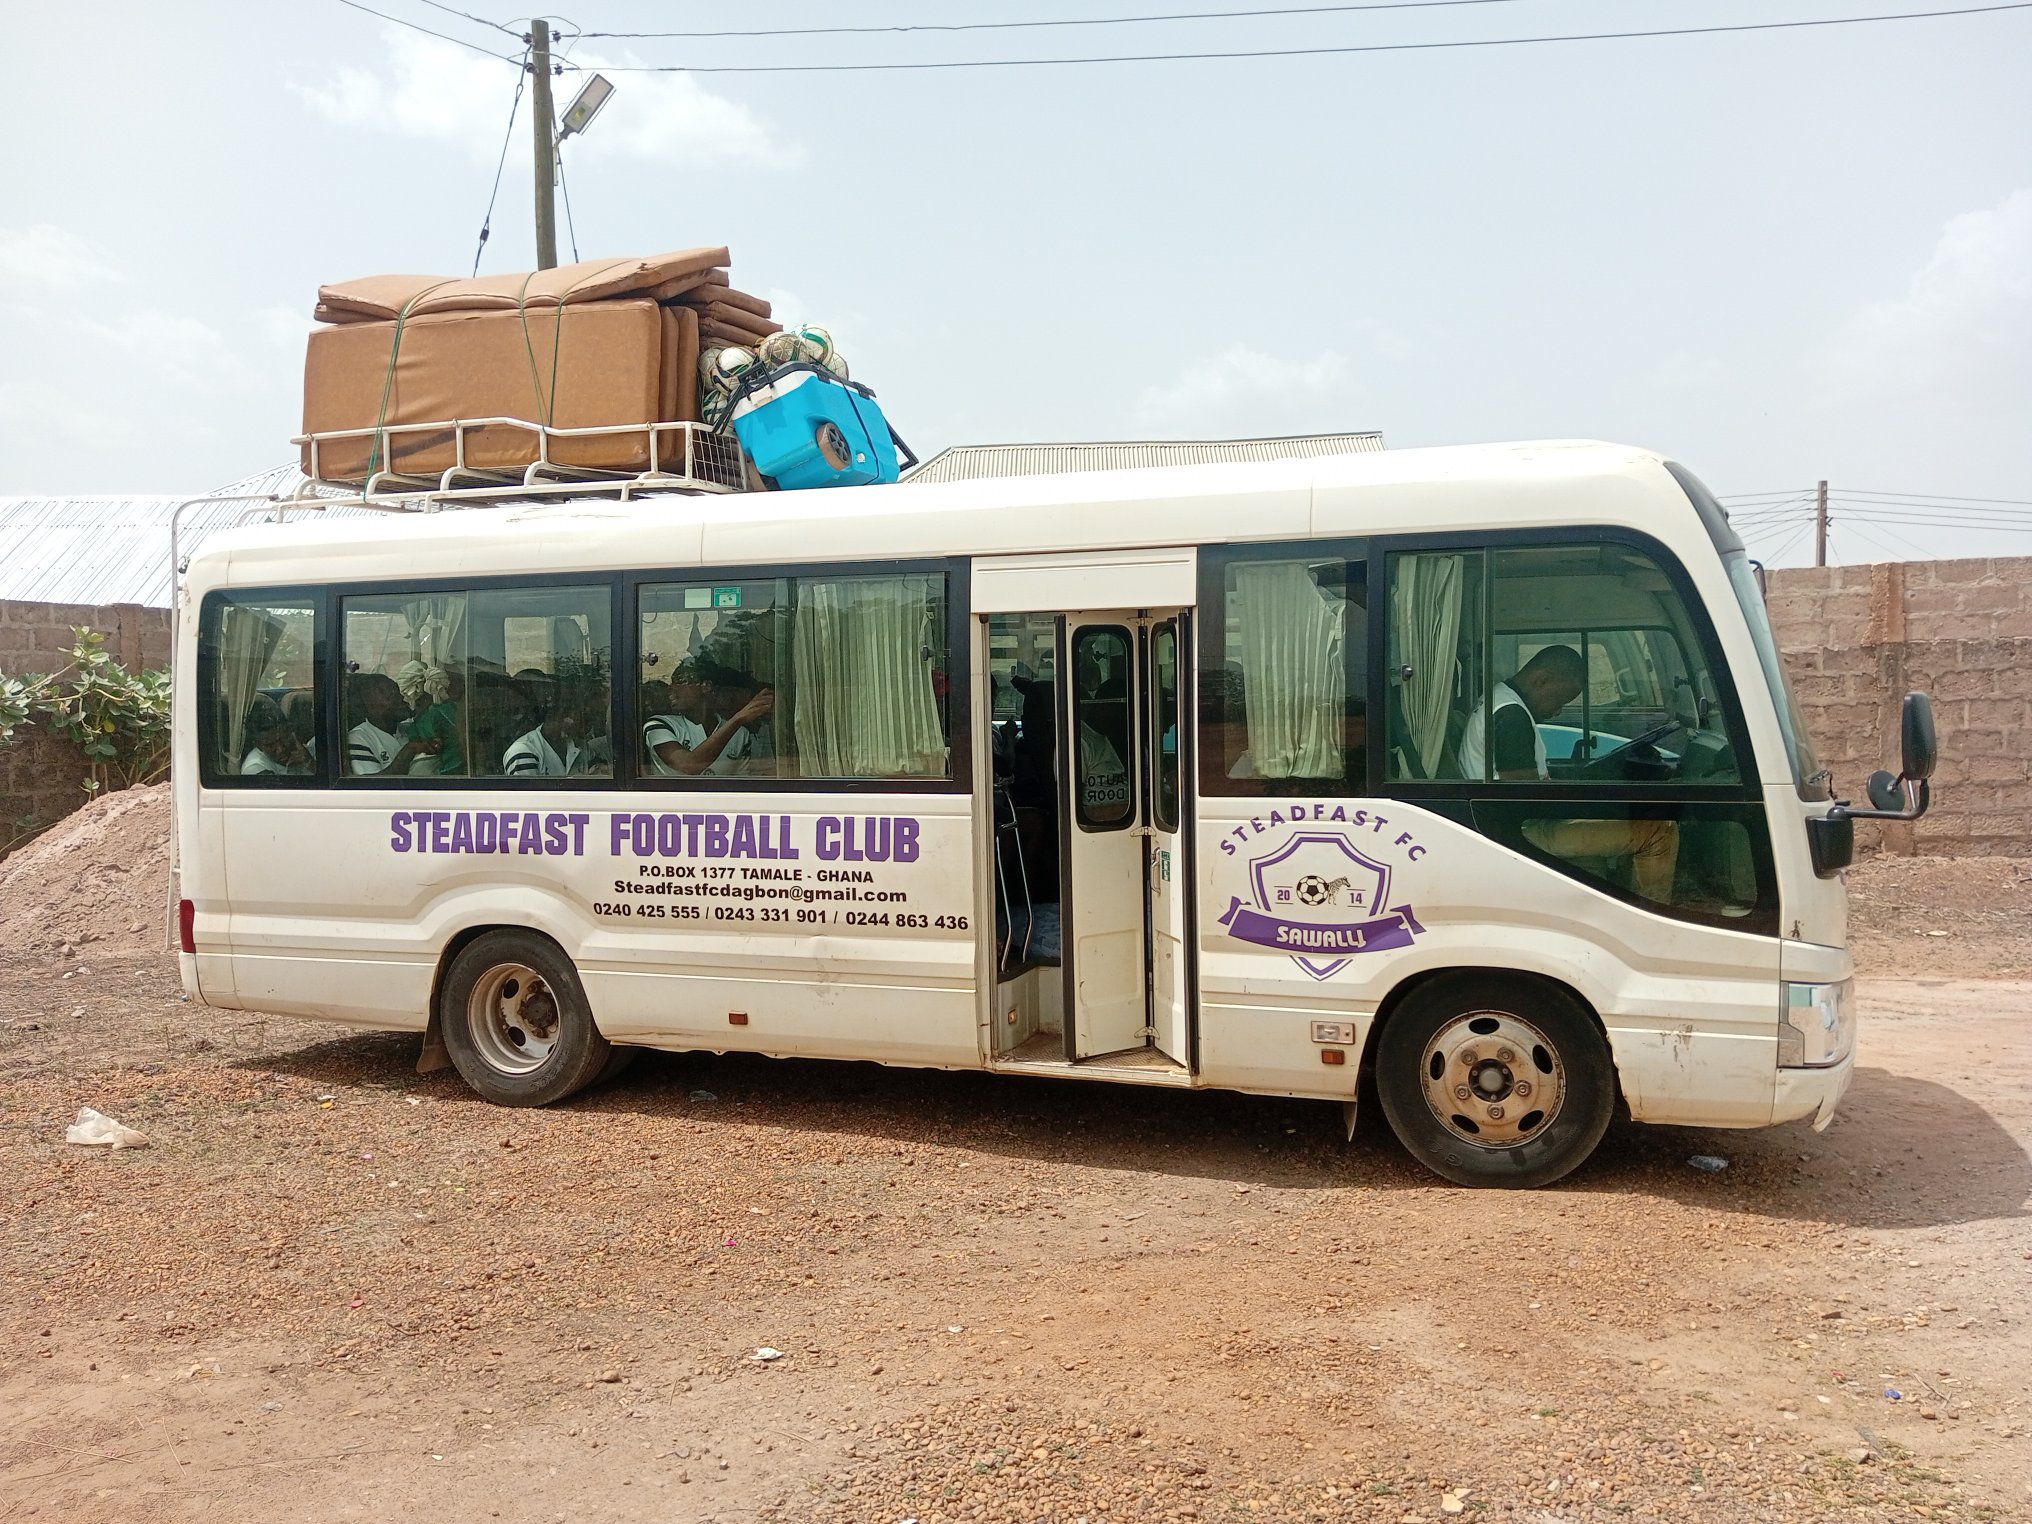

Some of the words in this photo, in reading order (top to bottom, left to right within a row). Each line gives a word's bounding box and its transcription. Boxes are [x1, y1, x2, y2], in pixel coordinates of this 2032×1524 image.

[390, 811, 590, 856] STEADFAST
[611, 813, 799, 860] FOOTBALL
[815, 816, 920, 863] CLUB
[1220, 804, 1388, 856] STEADFAST
[1394, 832, 1427, 862] FC
[639, 865, 696, 878] P.O.BOX
[700, 867, 736, 880] 1377
[740, 868, 803, 881] TAMALE
[816, 869, 874, 883] GHANA
[614, 880, 907, 903] Steadfastfcdagbon@gmail.com
[1277, 889, 1291, 901] 20
[1350, 893, 1363, 904] 14
[593, 902, 632, 917] 0240
[636, 904, 666, 918] 425
[671, 905, 701, 919] 555
[705, 906, 710, 920] /
[714, 907, 755, 921] 0243
[760, 908, 790, 922] 331
[796, 909, 827, 924] 901
[833, 911, 838, 924] /
[845, 912, 889, 926] 0244
[895, 913, 929, 928] 863
[934, 915, 969, 930] 436
